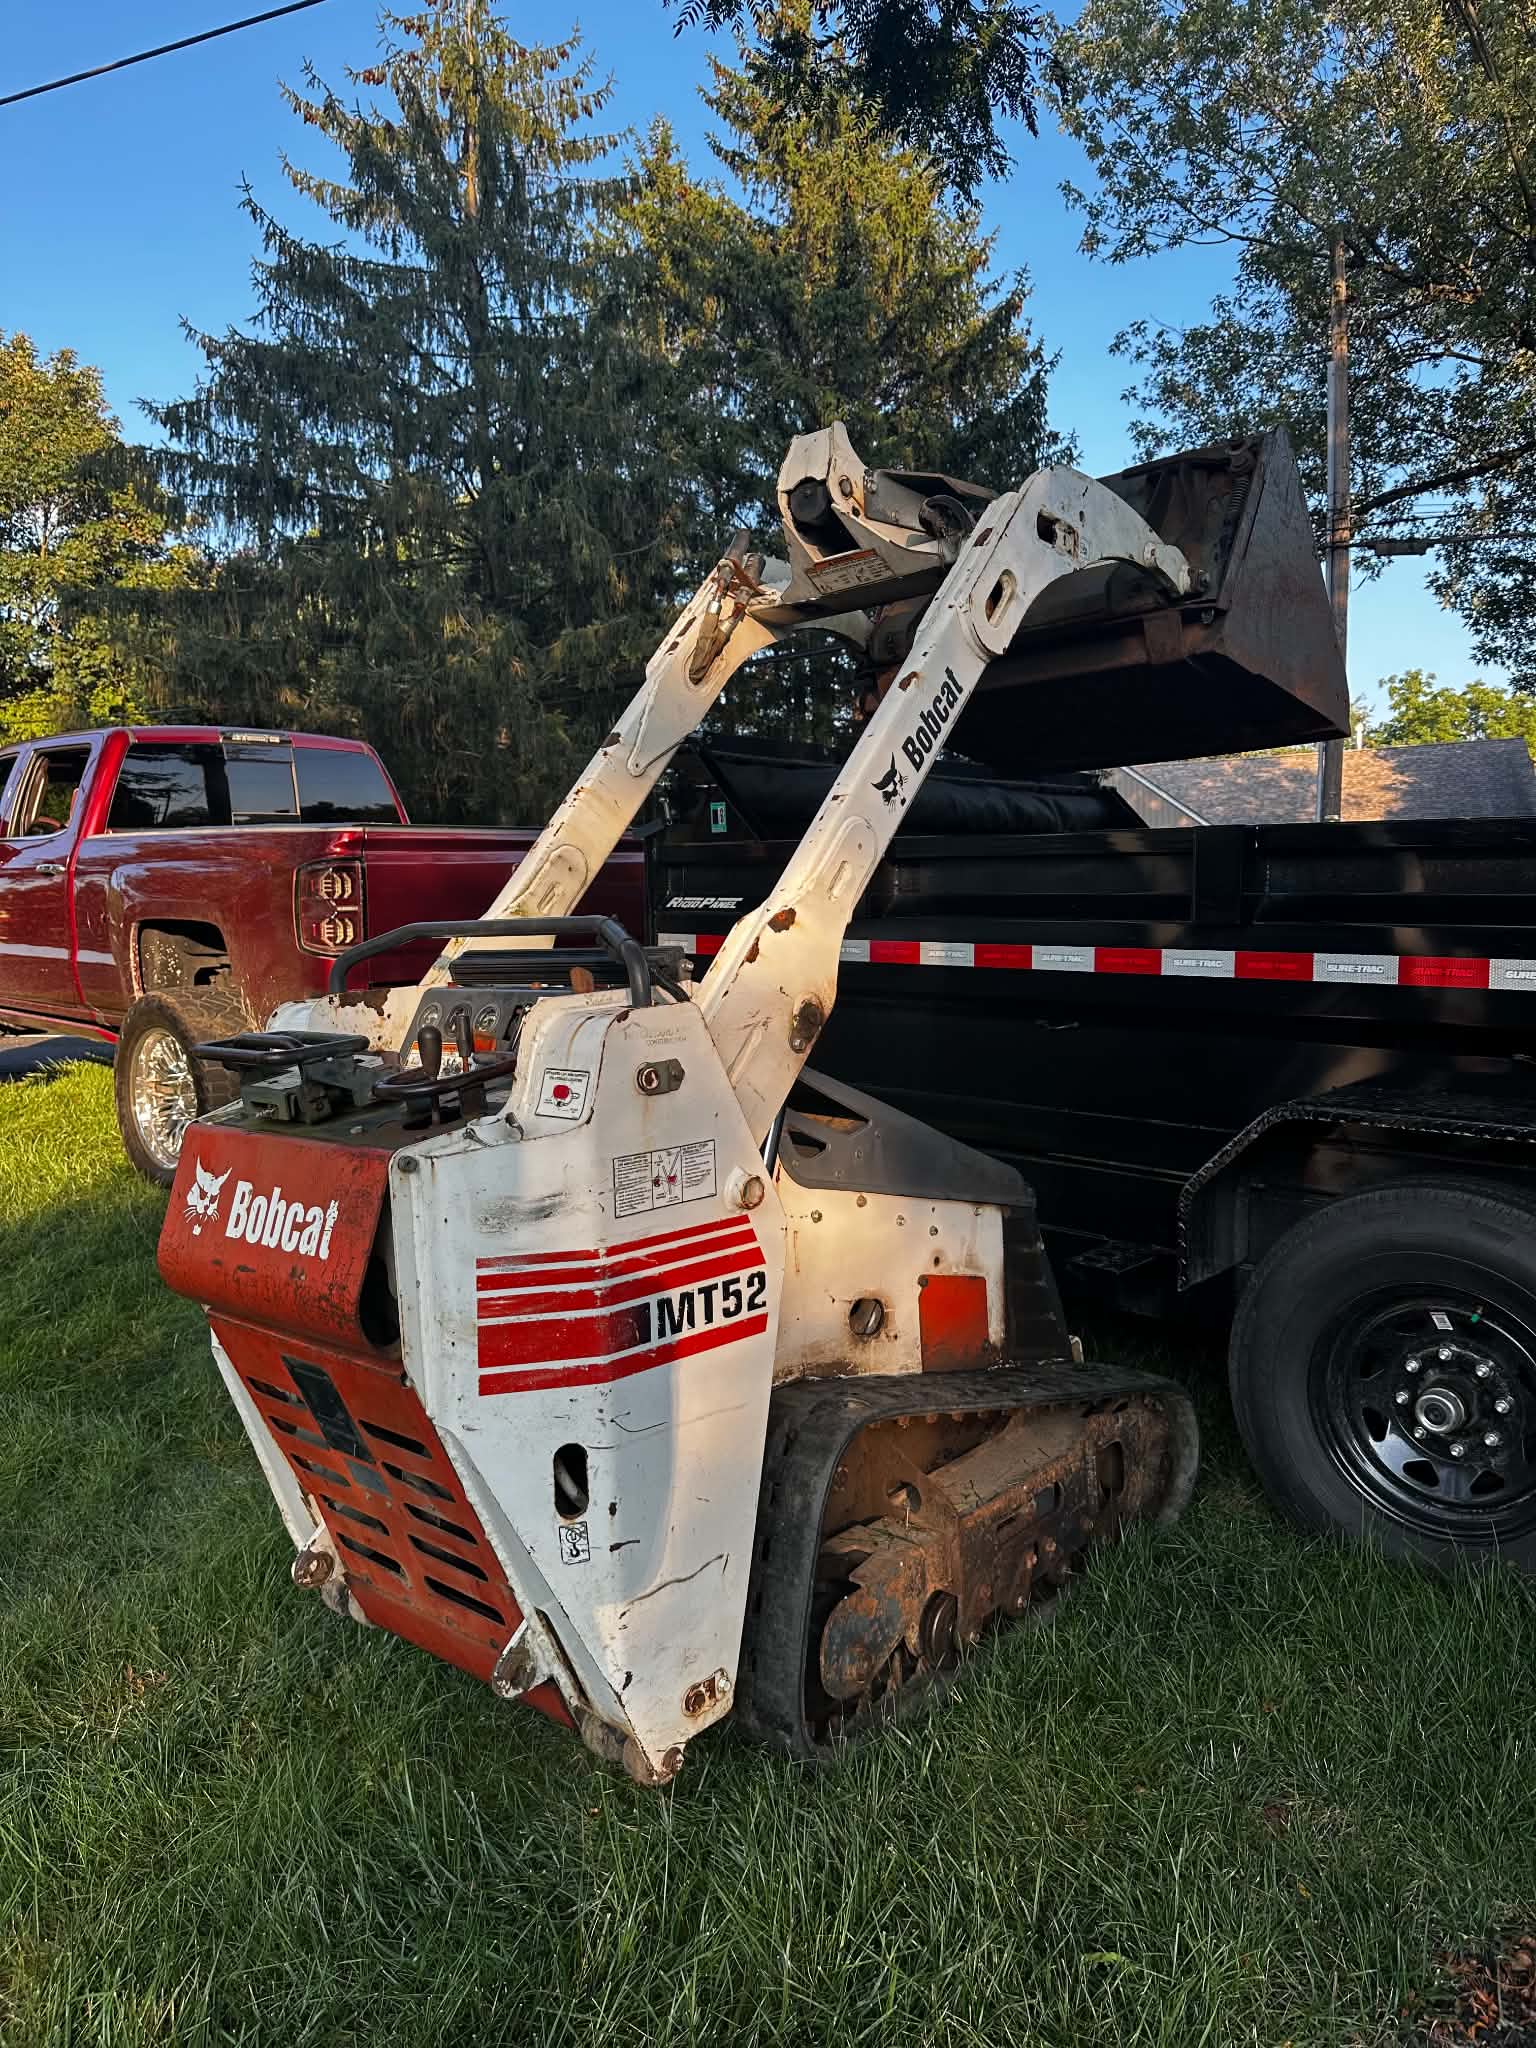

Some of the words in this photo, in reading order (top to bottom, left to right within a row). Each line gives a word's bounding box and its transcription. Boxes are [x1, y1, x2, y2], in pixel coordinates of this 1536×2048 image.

[901, 666, 964, 772] Bobcat
[225, 1180, 339, 1261] Bobcat
[656, 1271, 767, 1340] MT52
